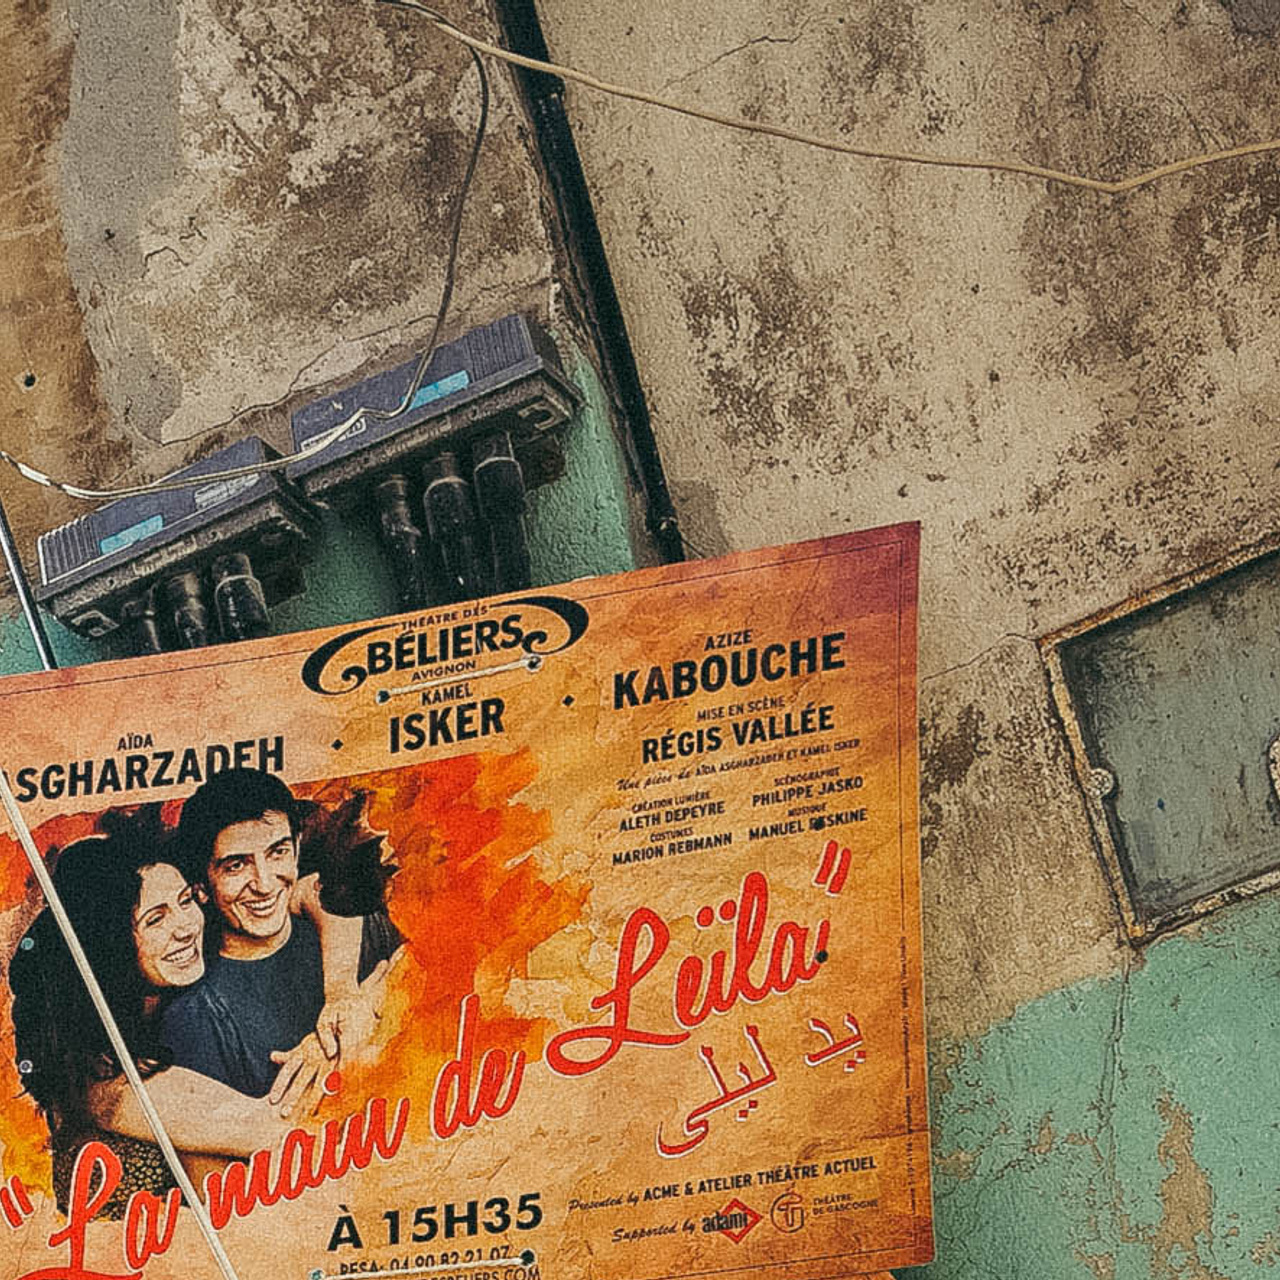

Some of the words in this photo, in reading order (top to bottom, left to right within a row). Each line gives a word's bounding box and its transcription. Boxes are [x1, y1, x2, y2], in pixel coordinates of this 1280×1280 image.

[367, 614, 523, 676] BÉLIERS
[704, 629, 754, 651] AZIZE
[411, 660, 476, 681] AVIGNON
[613, 632, 846, 710] KABOUCHE
[421, 683, 473, 706] KAMEL
[696, 707, 725, 723] MISE
[728, 704, 744, 717] EN
[747, 695, 785, 713] SCÈNE
[390, 698, 506, 753] ISKER
[641, 728, 722, 764] RÉGIS
[732, 702, 835, 747] VALLÉE
[118, 732, 153, 752] AÏDA
[752, 784, 813, 807] PHILIPPE
[819, 776, 864, 796] JASKO
[619, 812, 661, 833] ALETH
[665, 801, 726, 824] DEPEYRE
[748, 818, 805, 841] MANUEL
[612, 843, 664, 866] MARION
[668, 832, 733, 856] REBMANN
[205, 1071, 410, 1231] main
[432, 993, 526, 1140] de
[643, 1184, 680, 1201] ACME
[684, 1181, 694, 1196] &
[697, 1173, 753, 1194] ATELIER
[756, 1164, 820, 1188] THÉÂTRE
[823, 1155, 878, 1177] ACTUEL
[327, 1204, 363, 1251] À
[383, 1192, 544, 1245] 15H35
[611, 1222, 678, 1244] Supported
[681, 1217, 696, 1237] by
